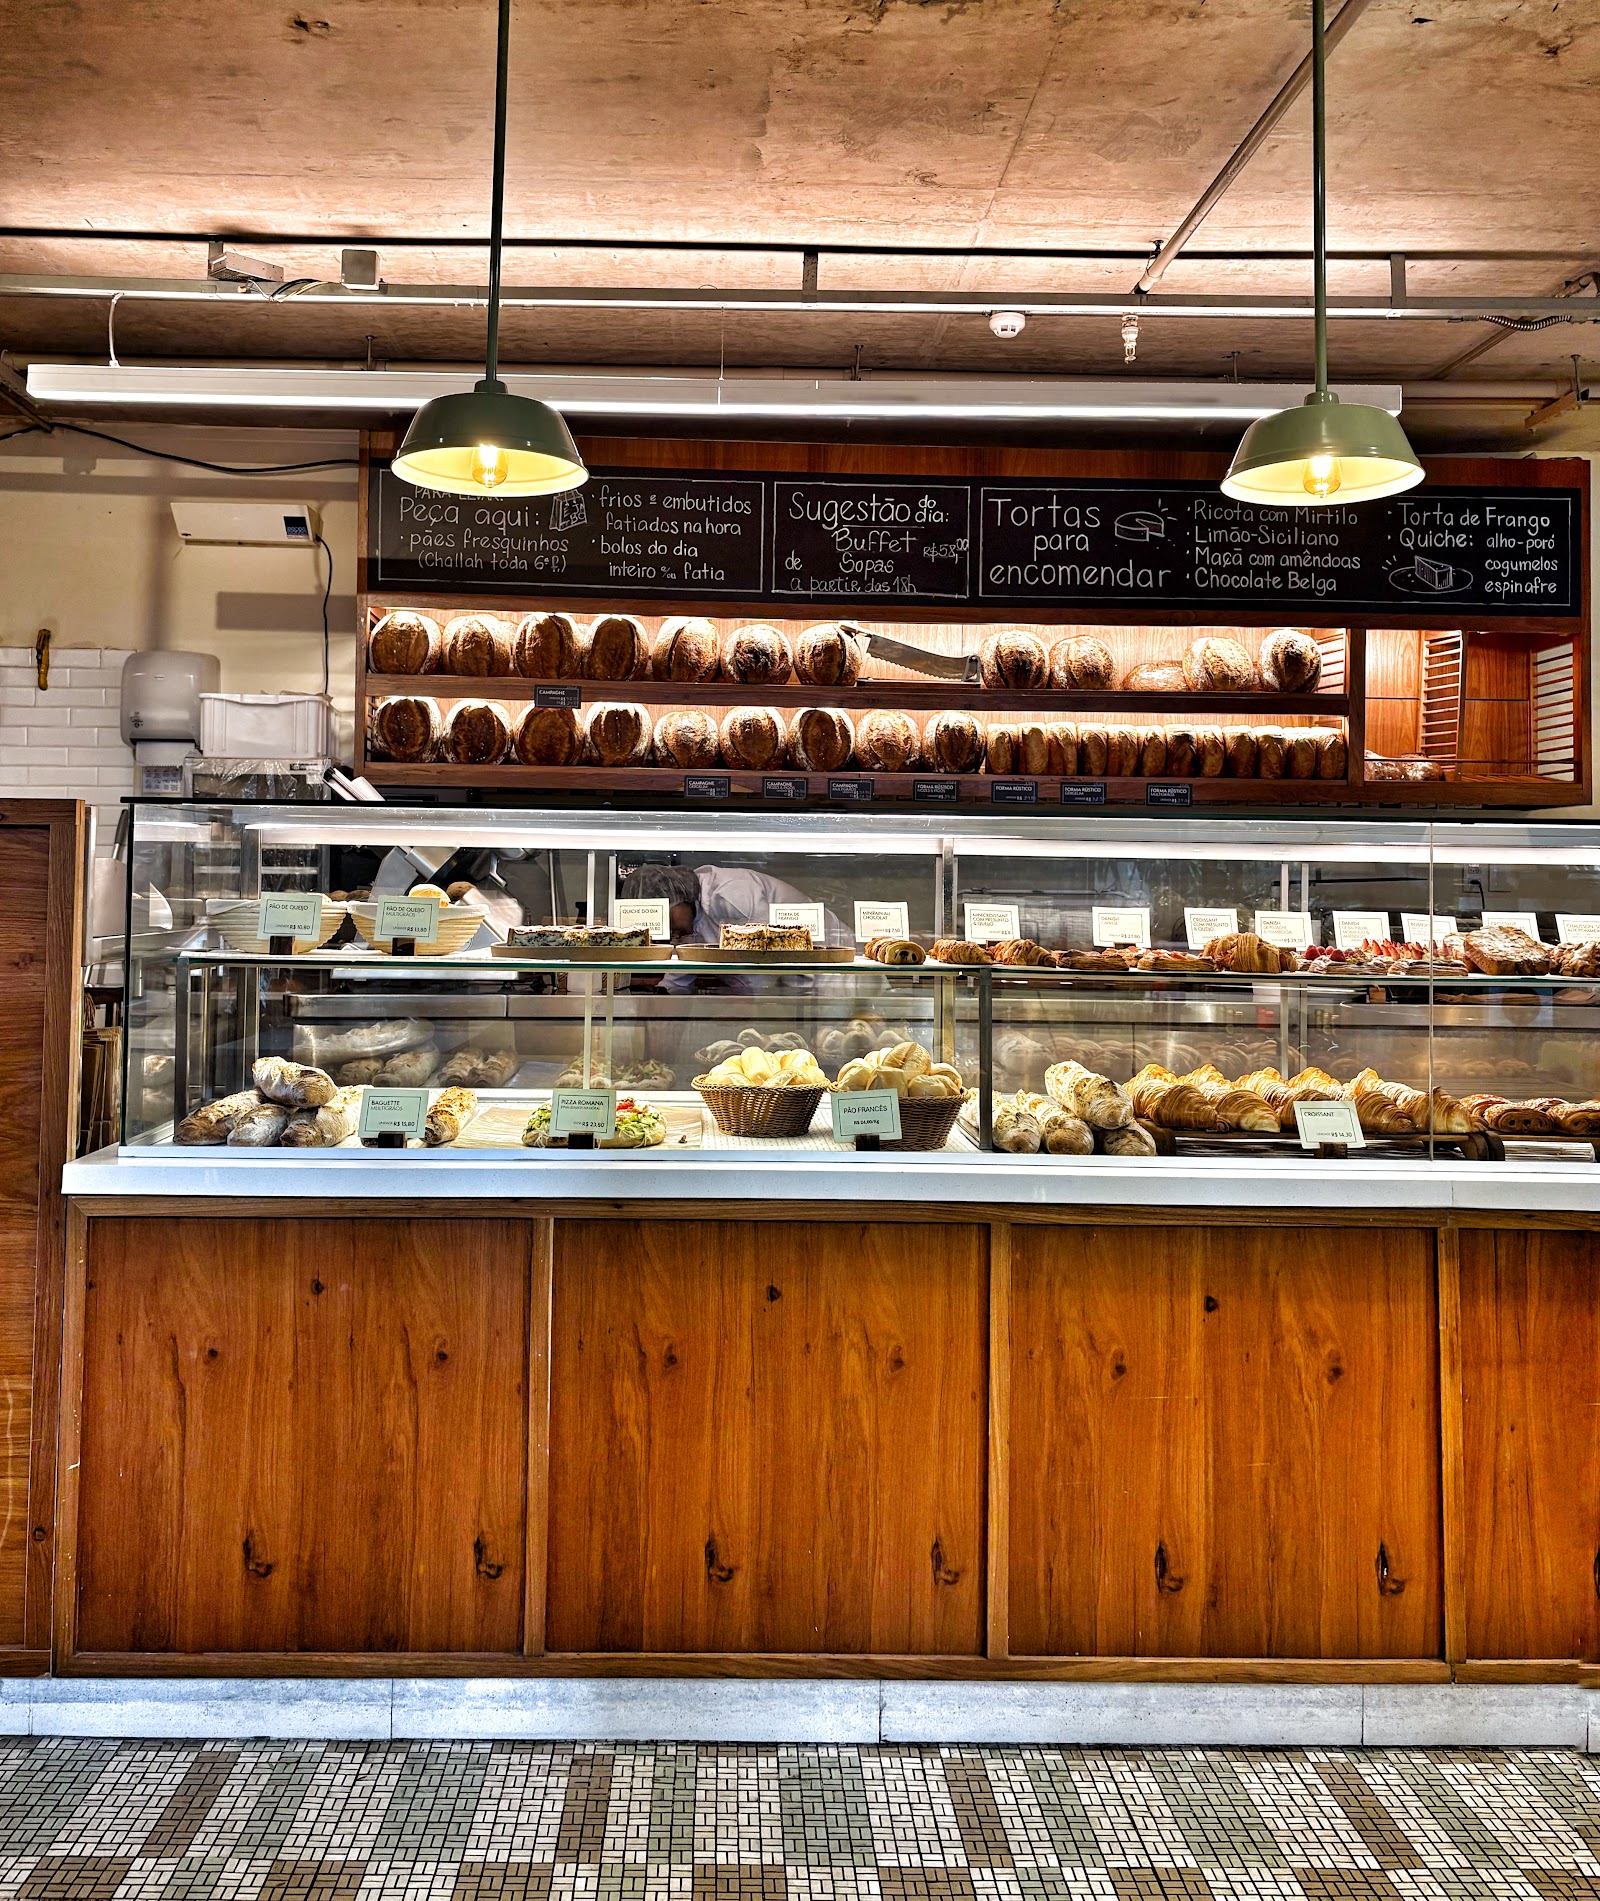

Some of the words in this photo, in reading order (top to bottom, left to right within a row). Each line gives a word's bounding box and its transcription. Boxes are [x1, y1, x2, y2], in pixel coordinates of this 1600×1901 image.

[599, 484, 643, 508] frios
[662, 491, 752, 515] embutidos
[789, 491, 911, 530] Sugestão
[918, 494, 936, 508] do
[988, 494, 1100, 528] Tortas
[1194, 499, 1254, 522] Ricota
[1259, 509, 1288, 522] com
[1295, 506, 1358, 525] Mirtilo
[400, 497, 459, 526] Peça
[475, 506, 540, 536] aqui:
[606, 512, 679, 534] fatiados
[683, 522, 702, 534] na
[705, 517, 742, 536] hora
[915, 508, 950, 523] dia:
[1397, 503, 1454, 526] Torta
[1460, 508, 1480, 526] de
[1486, 507, 1550, 536] Frango
[410, 529, 456, 552] pães
[463, 528, 569, 558] fresquinhos
[600, 535, 642, 555] bolos
[648, 540, 668, 555] do
[672, 539, 698, 558] dia
[831, 527, 917, 552] Buffet
[1034, 534, 1089, 562] para
[1195, 525, 1339, 546] Limão-Siciliano
[1400, 528, 1474, 550] Quiche:
[1486, 533, 1555, 554] alho-poró
[418, 550, 483, 569] (Challah
[490, 553, 528, 570] toda
[609, 561, 656, 579] inteiro
[684, 562, 725, 581] fatia
[784, 550, 802, 571] de
[839, 552, 894, 581] Sopas
[1195, 547, 1242, 568] Maçã
[1248, 553, 1275, 567] com
[1280, 549, 1361, 570] amêndoas
[1485, 556, 1558, 578] cogumelos
[790, 578, 803, 591] a
[865, 578, 890, 593] das
[893, 574, 917, 593] 18h
[990, 559, 1172, 588] encomendar
[1195, 566, 1283, 589] Chocolate
[1288, 571, 1337, 596] Belga
[1484, 576, 1557, 600] espinafre
[858, 1104, 888, 1113] FRANCÊS
